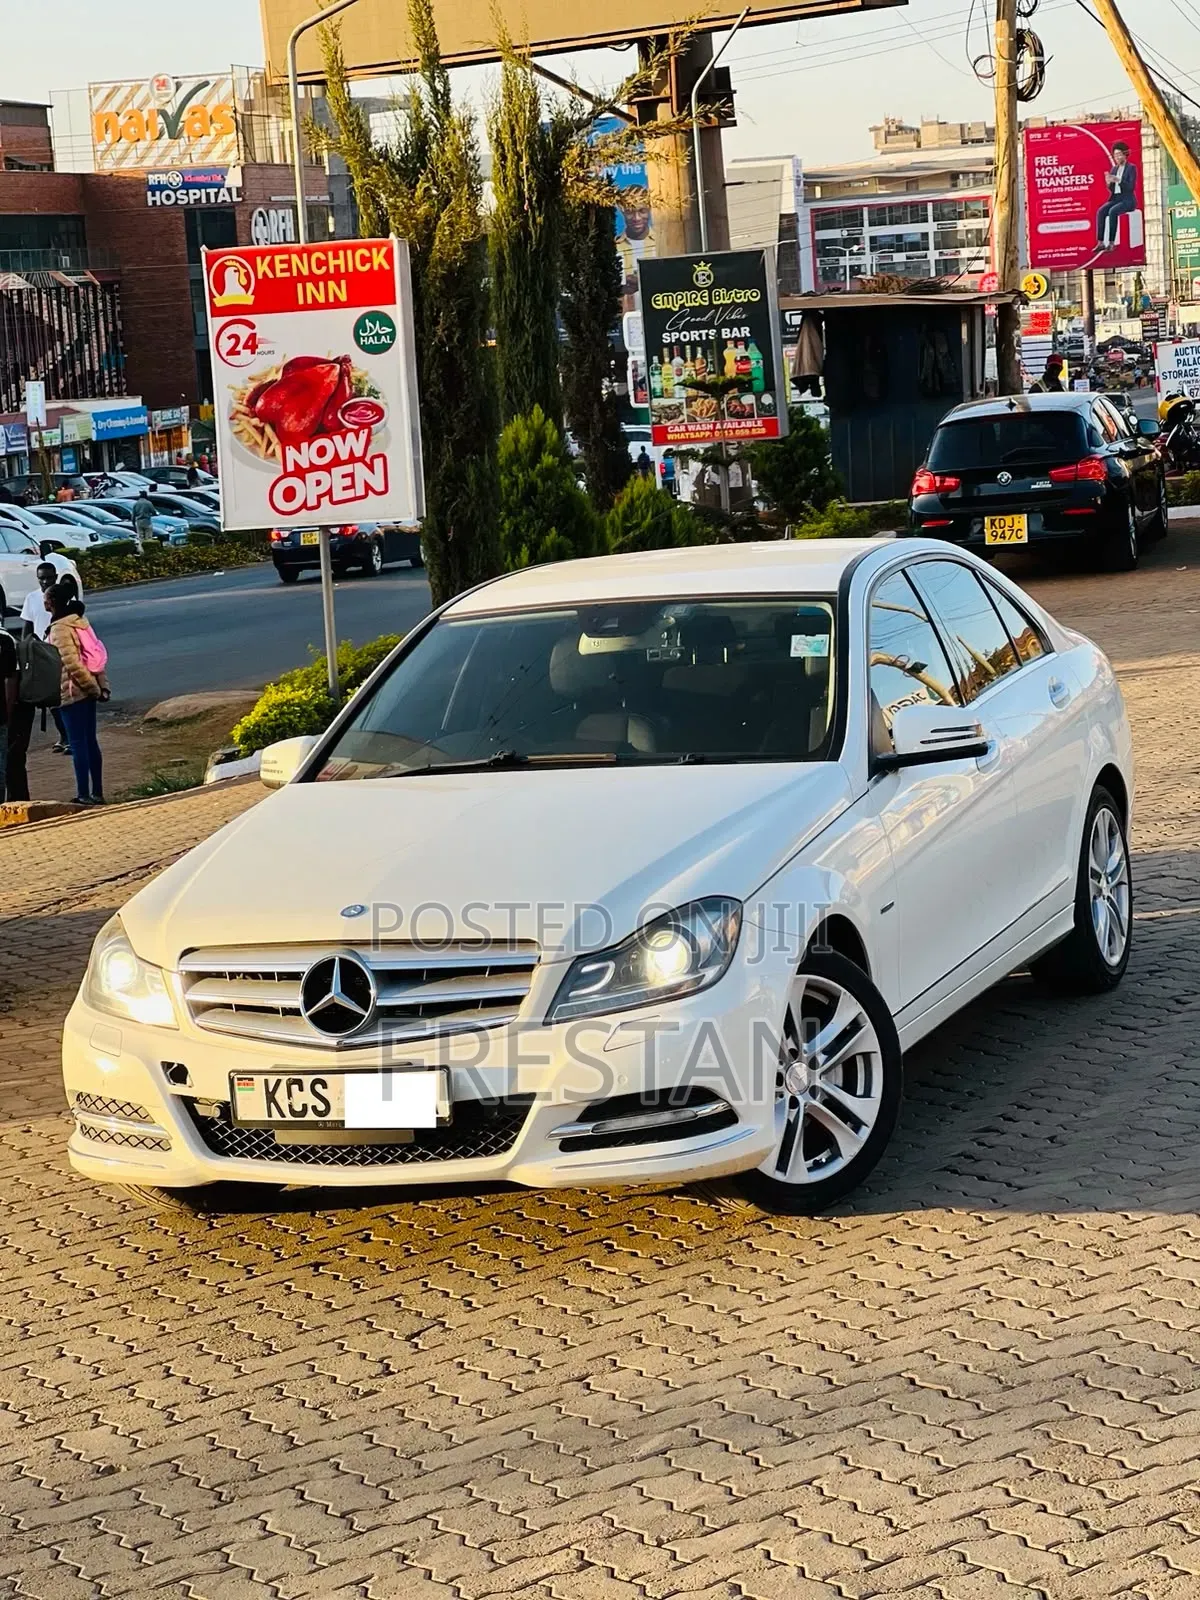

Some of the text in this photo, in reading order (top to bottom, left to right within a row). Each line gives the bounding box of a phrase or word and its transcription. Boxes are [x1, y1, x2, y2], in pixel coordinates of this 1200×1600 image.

[620, 164, 642, 176] the
[1034, 156, 1059, 167] FREE
[1035, 165, 1074, 178] MONEY
[1035, 174, 1095, 188] TRANSFERS
[146, 187, 243, 207] HOSPITAL
[268, 208, 295, 243] RFH
[255, 246, 391, 280] KENCHICK
[296, 279, 348, 305] INN
[651, 287, 761, 311] EMPIRE Bistro
[359, 335, 393, 346] HALAL
[661, 326, 752, 343] SPORTS BAR
[225, 332, 259, 357] 24
[1161, 368, 1200, 381] STORAGE
[667, 424, 687, 433] CAR
[687, 422, 713, 431] WASH
[285, 428, 369, 473] NOW
[272, 456, 386, 513] OPEN
[990, 517, 1015, 530] KDJ
[990, 529, 1023, 541] 947C
[263, 1077, 332, 1119] KCS
